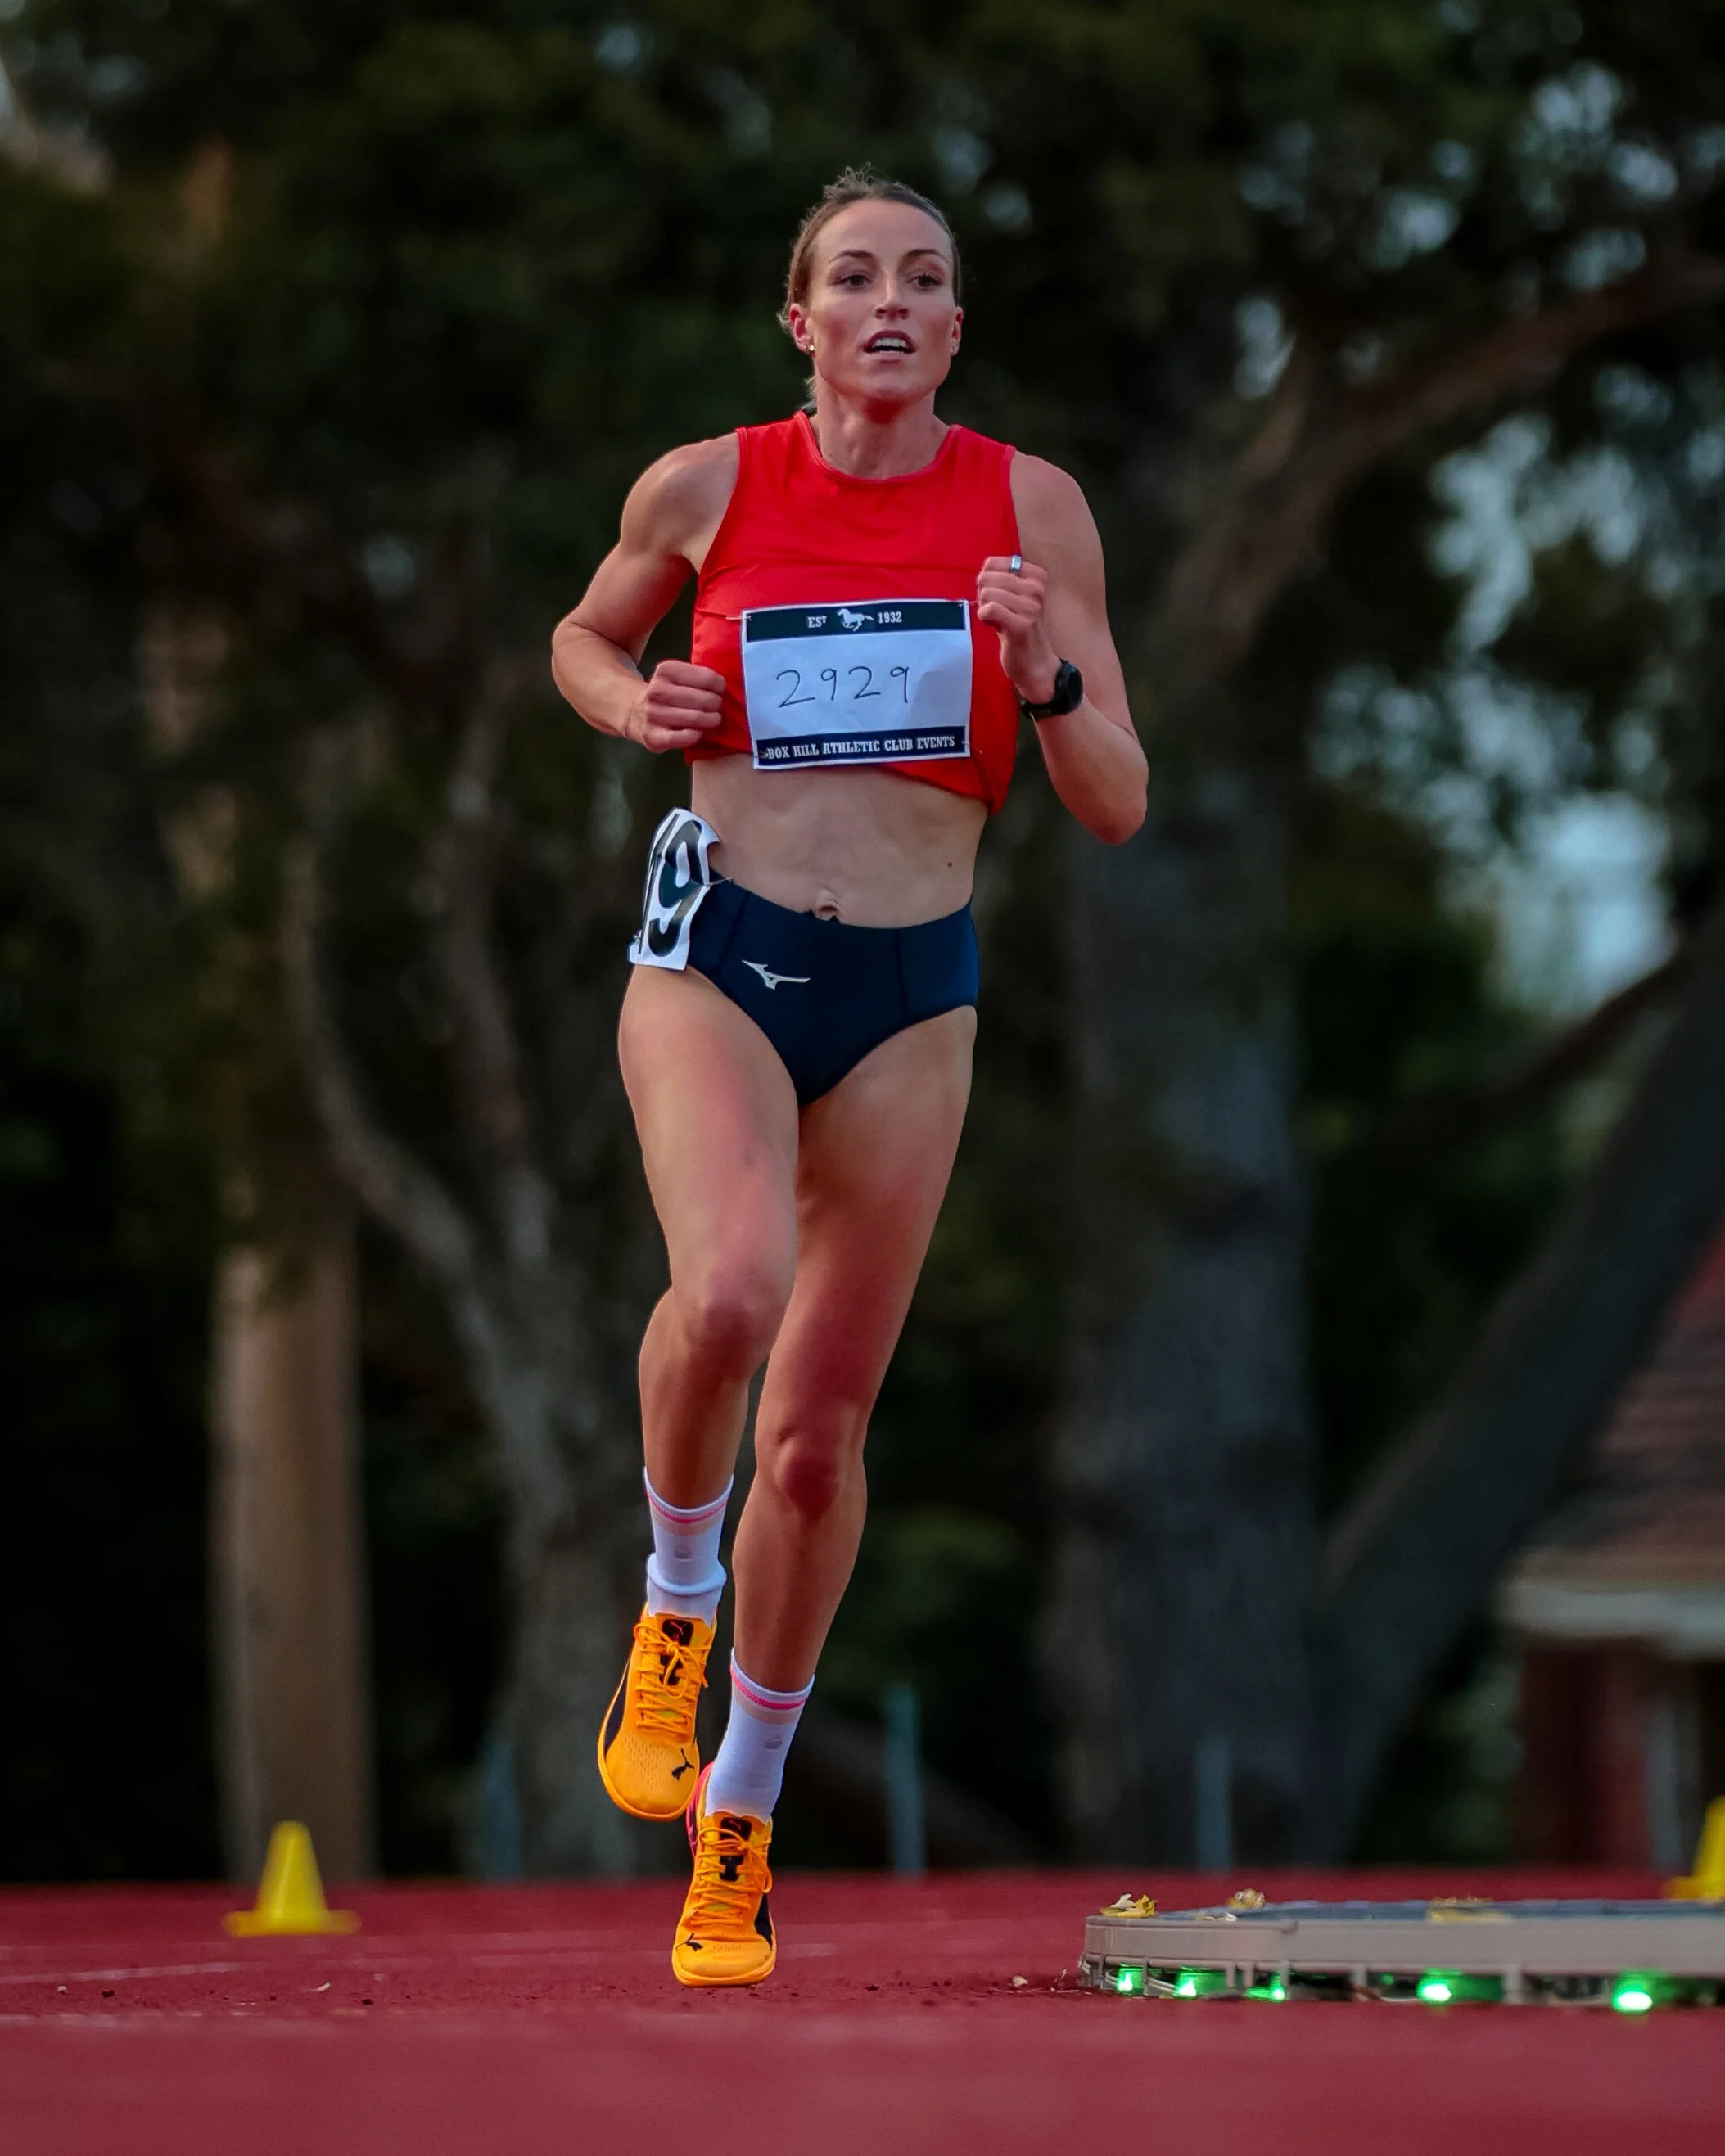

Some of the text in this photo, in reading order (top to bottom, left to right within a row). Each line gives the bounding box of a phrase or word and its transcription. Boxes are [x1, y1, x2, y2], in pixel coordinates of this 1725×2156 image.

[806, 611, 903, 629] EST 1932
[776, 666, 910, 708] 2929
[768, 736, 955, 760] BOX HILL ATHLETIC CLUB EVENTS
